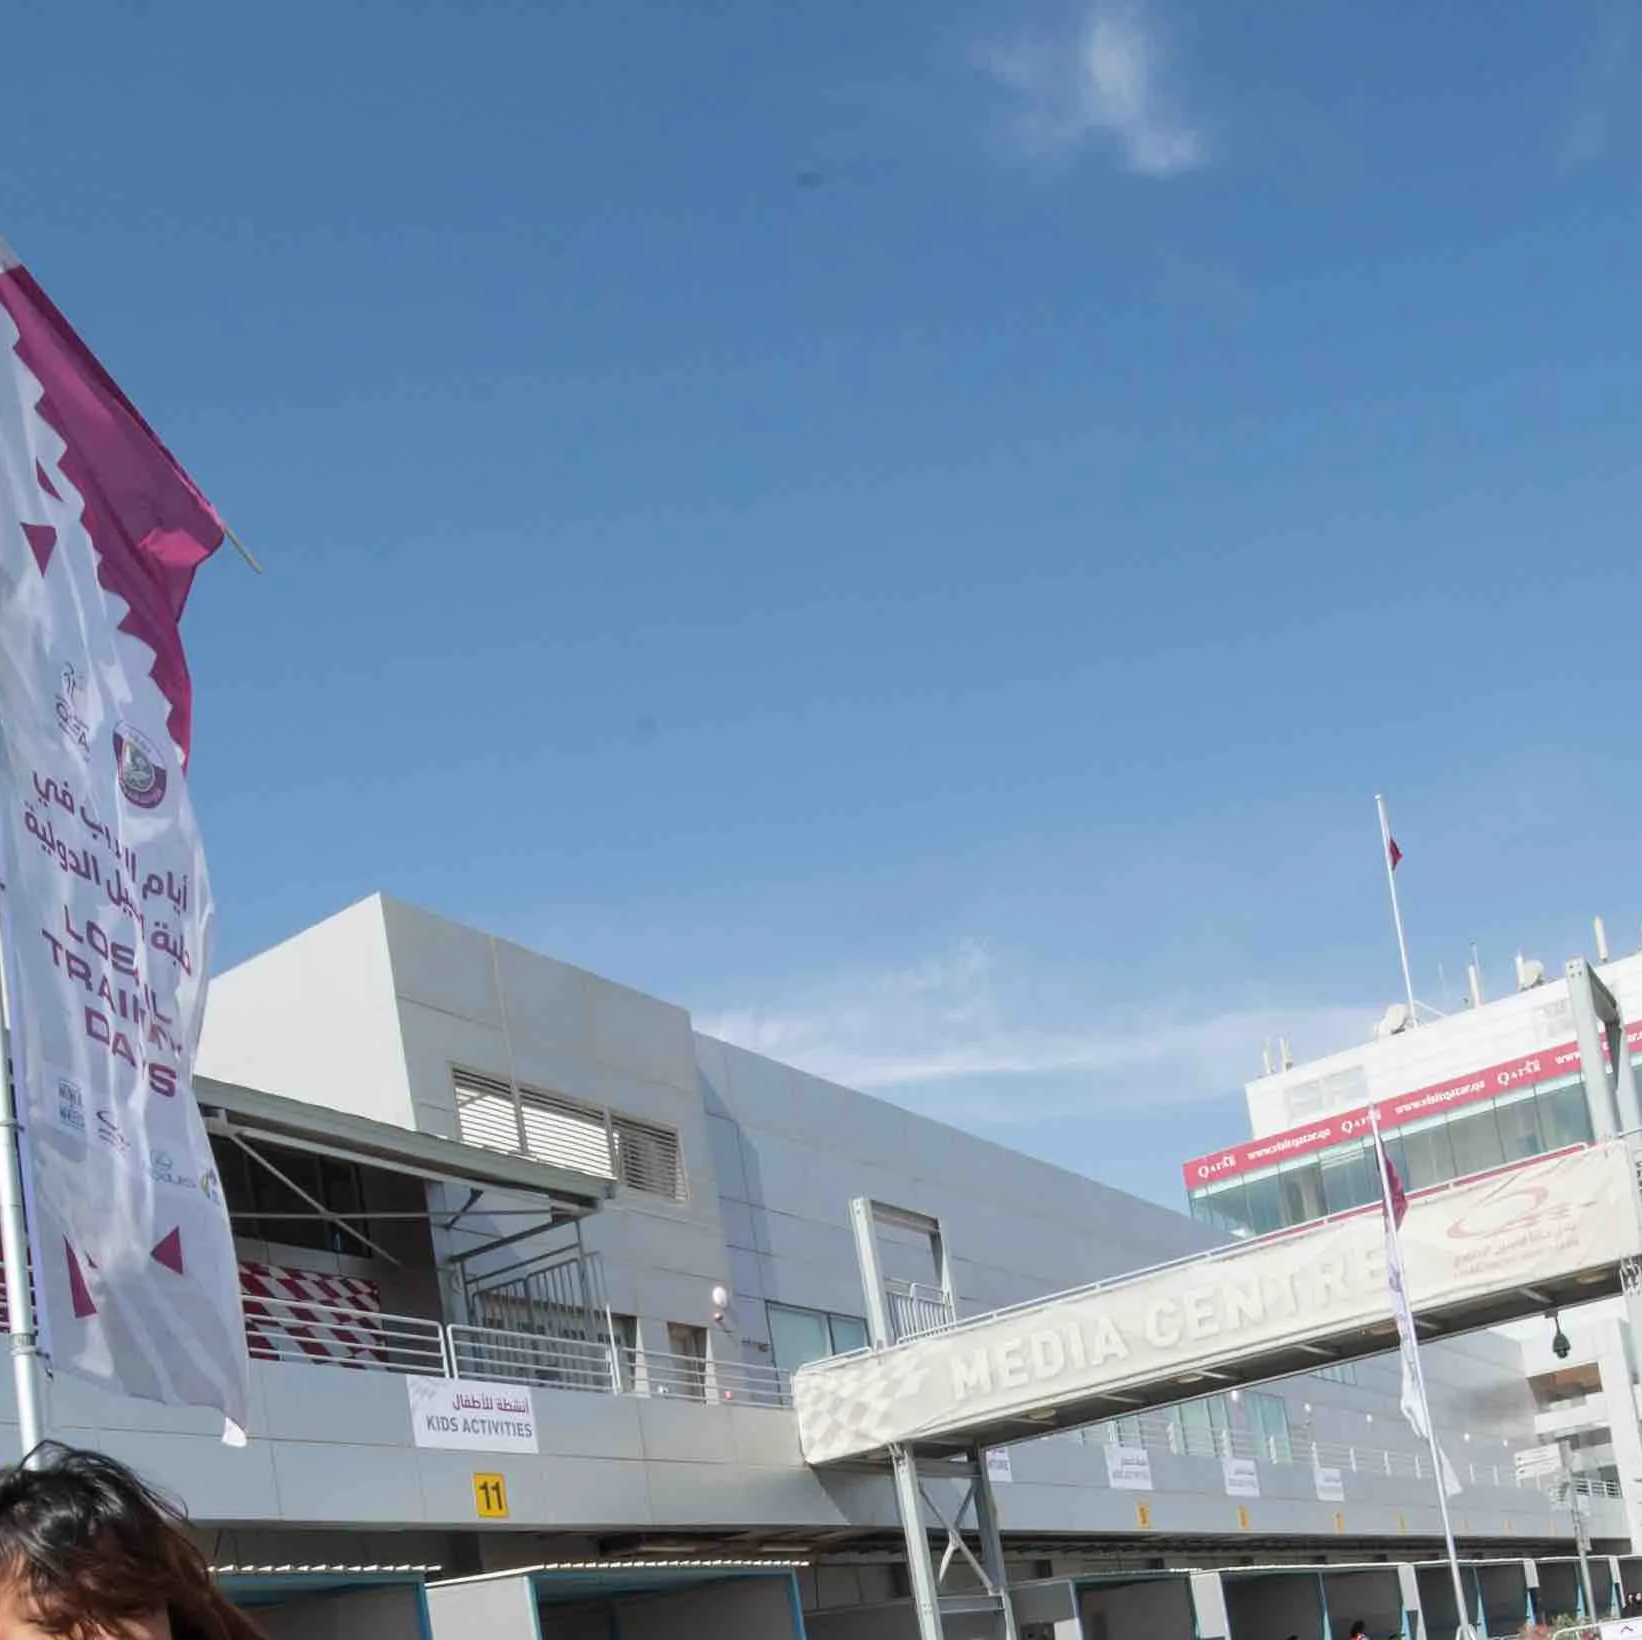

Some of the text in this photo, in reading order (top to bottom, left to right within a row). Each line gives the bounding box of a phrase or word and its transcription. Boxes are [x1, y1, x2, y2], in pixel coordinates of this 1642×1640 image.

[83, 1004, 178, 1098] DAS
[948, 1316, 1131, 1400] MEDIA
[1143, 1246, 1389, 1349] CENTRE
[426, 1415, 533, 1438] KIDS ACTIVITIES
[478, 1481, 503, 1511] 11
